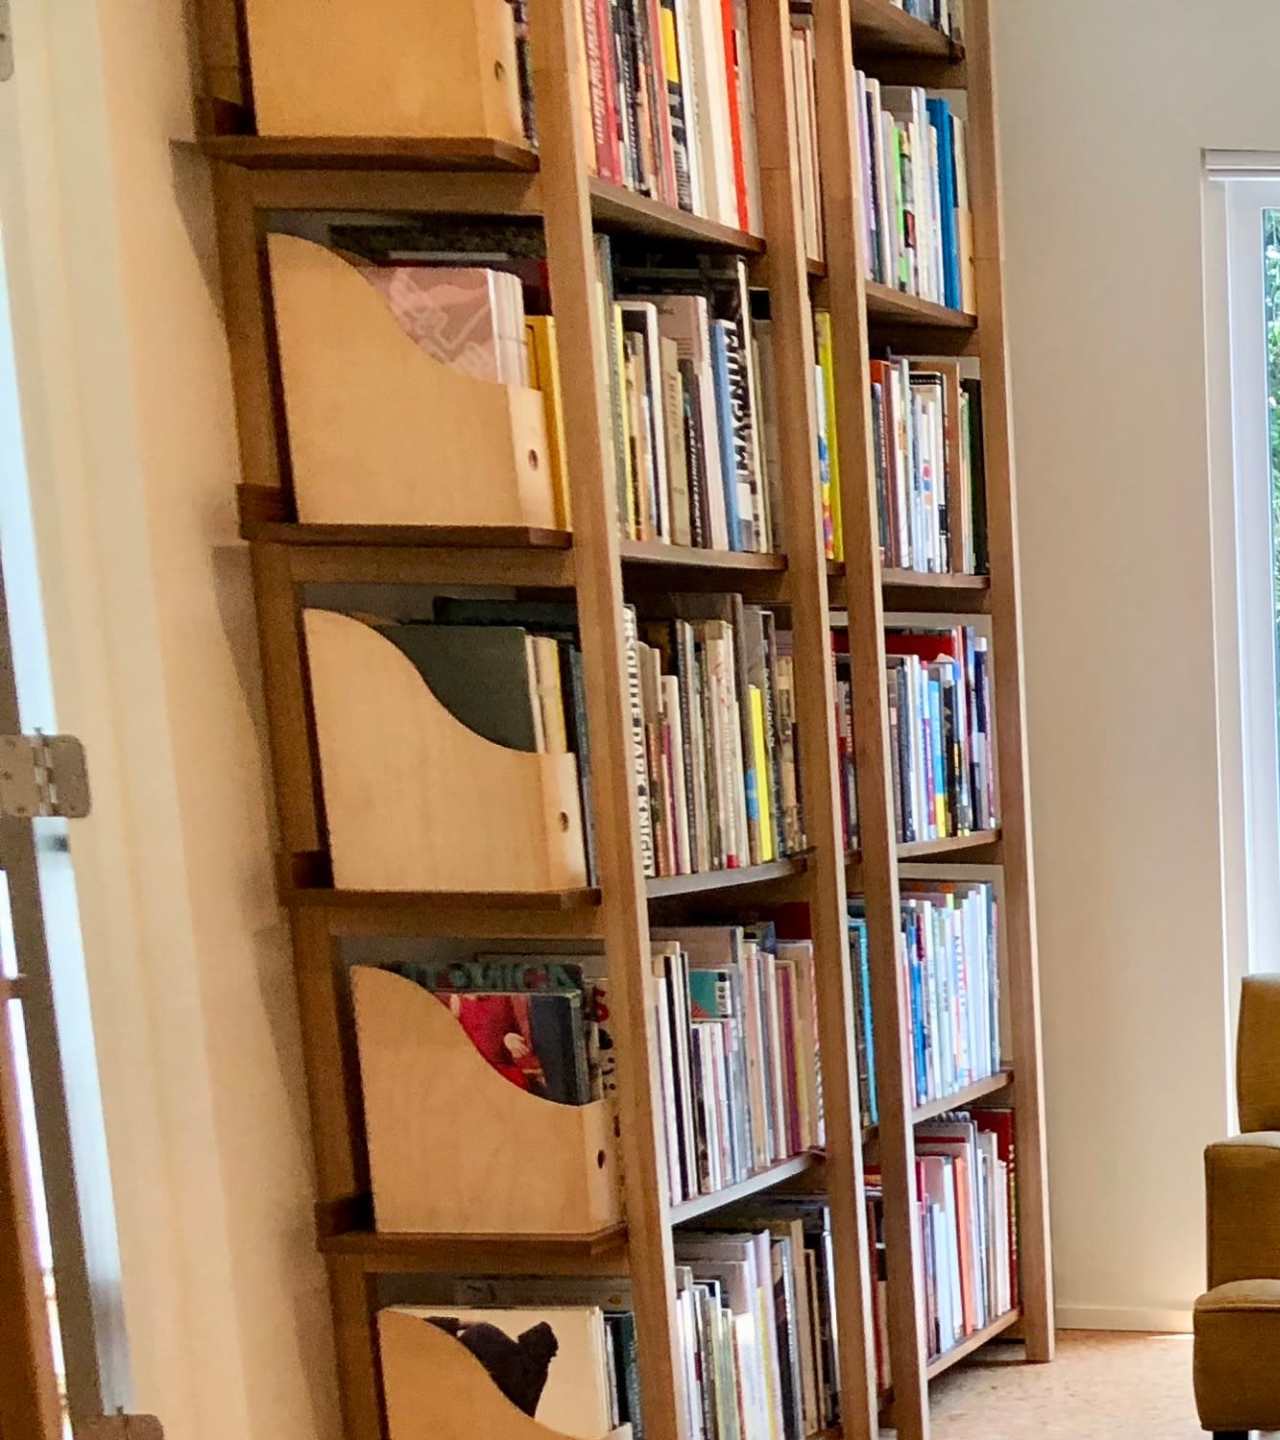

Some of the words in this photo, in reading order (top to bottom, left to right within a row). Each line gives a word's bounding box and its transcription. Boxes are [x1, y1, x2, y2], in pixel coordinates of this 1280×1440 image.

[724, 327, 751, 472] MAGNUM
[623, 607, 643, 718] ABSOLUTE
[632, 727, 648, 787] DARK
[637, 794, 656, 878] KNIGHT
